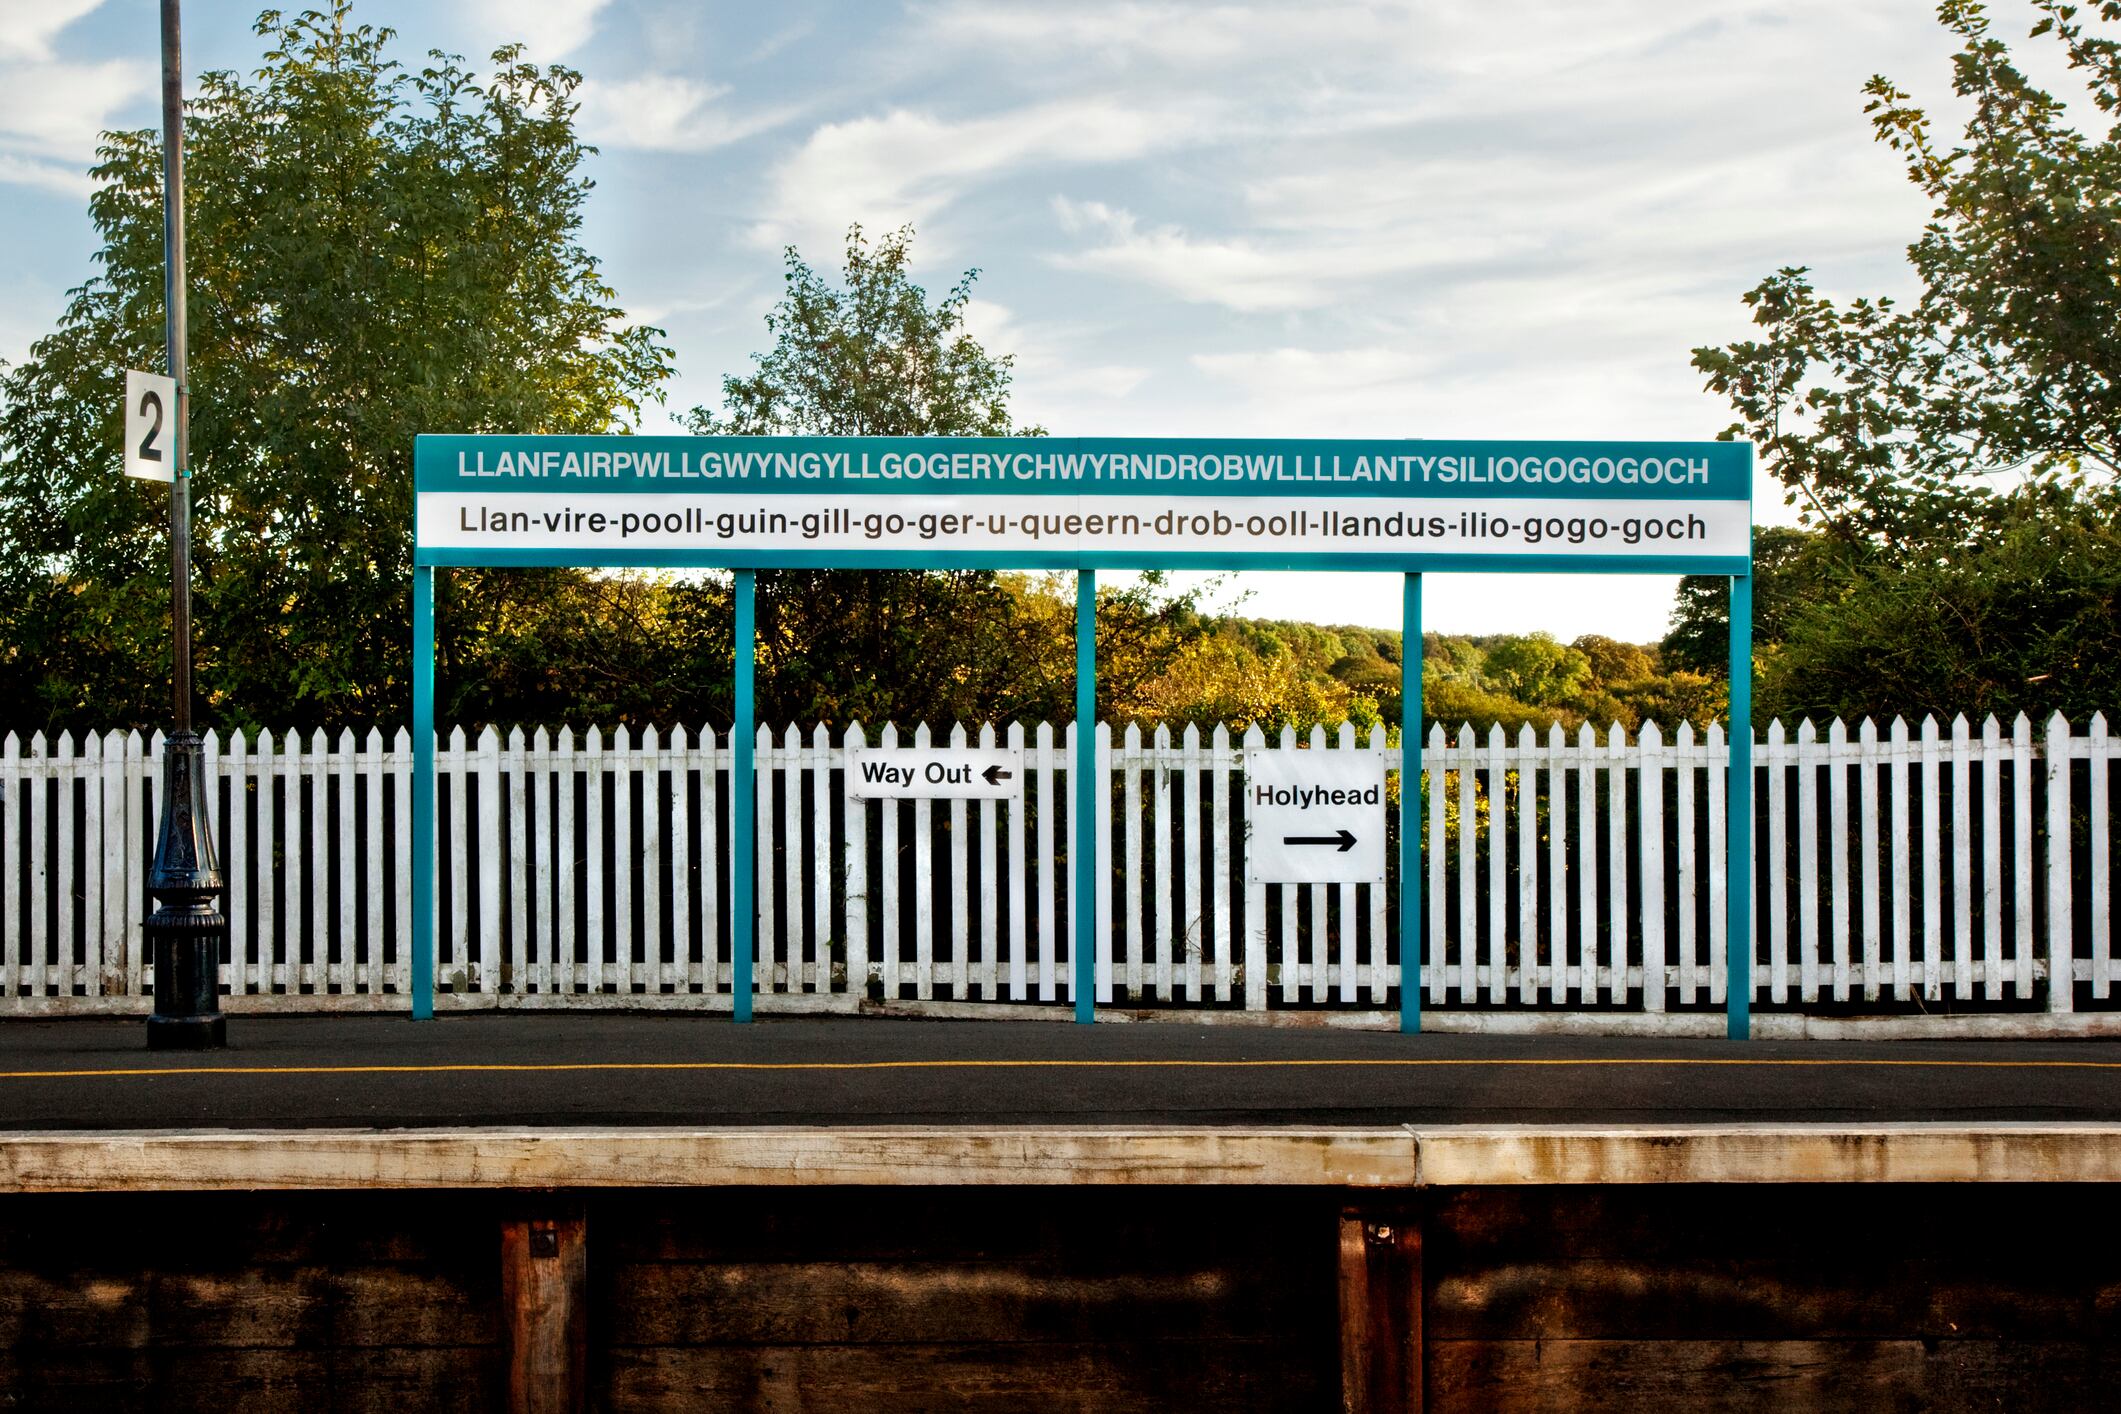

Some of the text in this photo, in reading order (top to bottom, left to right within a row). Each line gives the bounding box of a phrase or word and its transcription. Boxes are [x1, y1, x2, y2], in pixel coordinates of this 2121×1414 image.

[139, 390, 163, 462] 2
[459, 451, 1709, 484] LLANFAIRPWLLGWYNGYLLGOGERYCHWYRNDROBWLLLLANTYSILIOGOGOGOCH
[460, 506, 1706, 544] Llan-vire-pooll-guin-gill-go-ger-u-queern-drob-ooll-llandus-ilio-gogo-goch
[861, 761, 972, 788] Way Out
[1256, 784, 1379, 810] Holyhead
